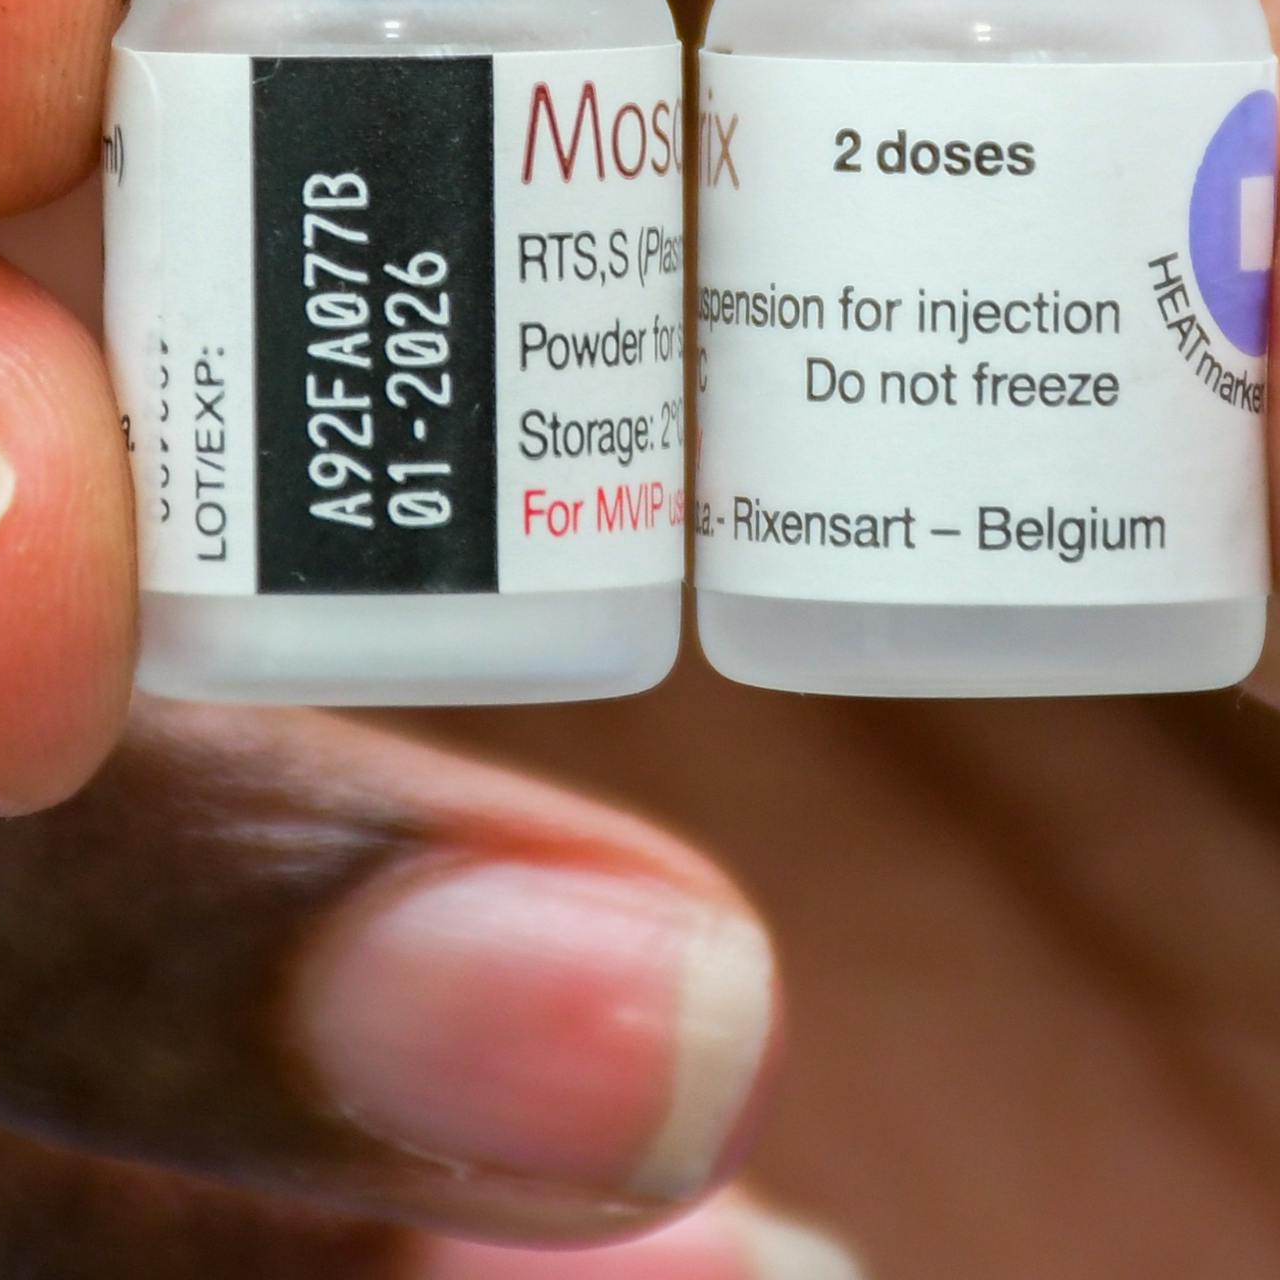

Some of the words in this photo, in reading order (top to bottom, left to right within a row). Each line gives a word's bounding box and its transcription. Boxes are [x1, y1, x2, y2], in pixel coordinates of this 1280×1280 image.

[832, 127, 862, 173] 2
[876, 128, 1036, 177] doses
[517, 228, 630, 287] RTS,S
[518, 317, 647, 372] Powder
[653, 313, 675, 363] for
[837, 285, 903, 332] for
[918, 288, 1121, 345] injection
[302, 172, 374, 528] A92FA077B
[383, 251, 452, 527] 01-2026
[806, 356, 866, 405] Do
[880, 363, 958, 407] not
[971, 361, 1120, 408] freeze
[194, 346, 228, 562] LOT/EXP:
[518, 408, 655, 468] Storage:
[523, 488, 585, 538] For
[596, 481, 663, 532] MVIP
[733, 495, 917, 550] Rixensart
[978, 505, 1166, 564] Belgium
